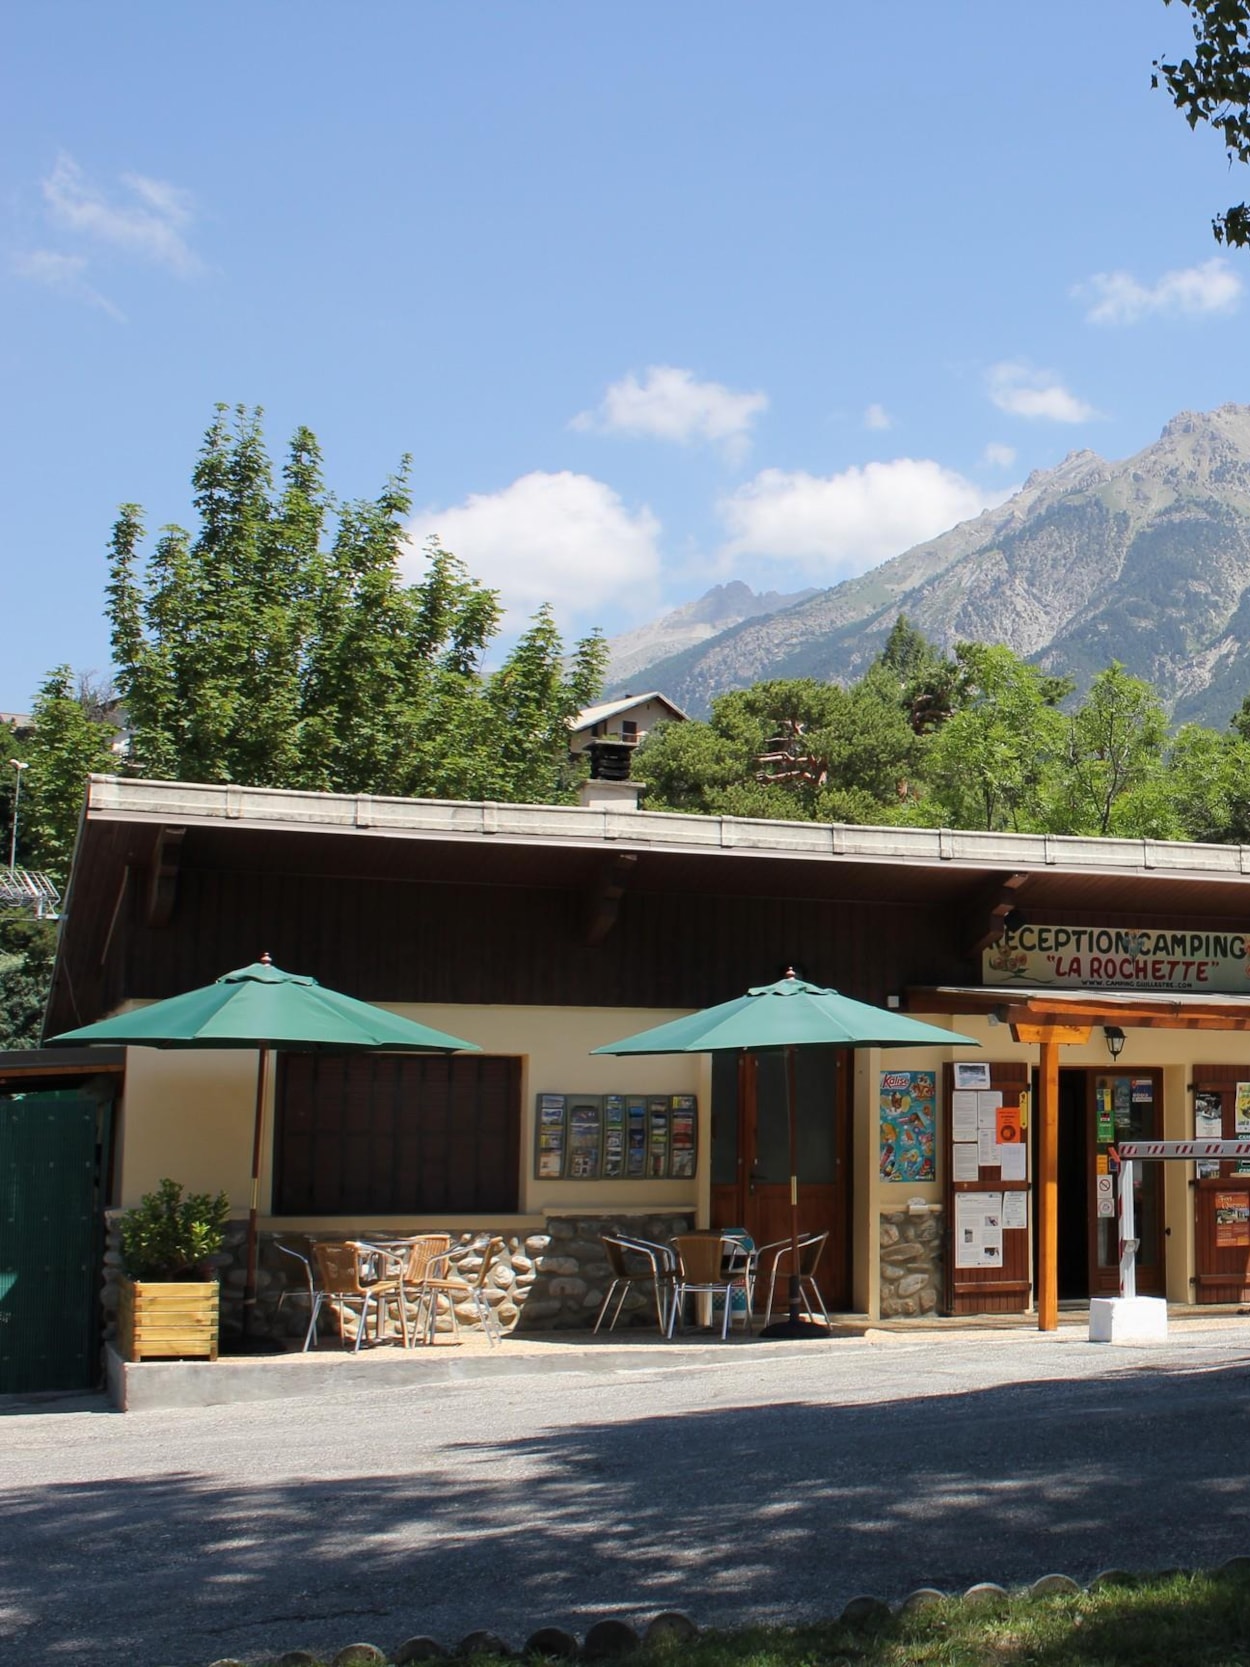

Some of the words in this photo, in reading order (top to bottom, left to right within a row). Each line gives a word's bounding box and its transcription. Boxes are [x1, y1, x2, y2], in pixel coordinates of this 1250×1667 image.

[1138, 932, 1247, 960] CAMPING
[1089, 957, 1220, 982] ROCHETTE"
[882, 1073, 909, 1088] Kalise
